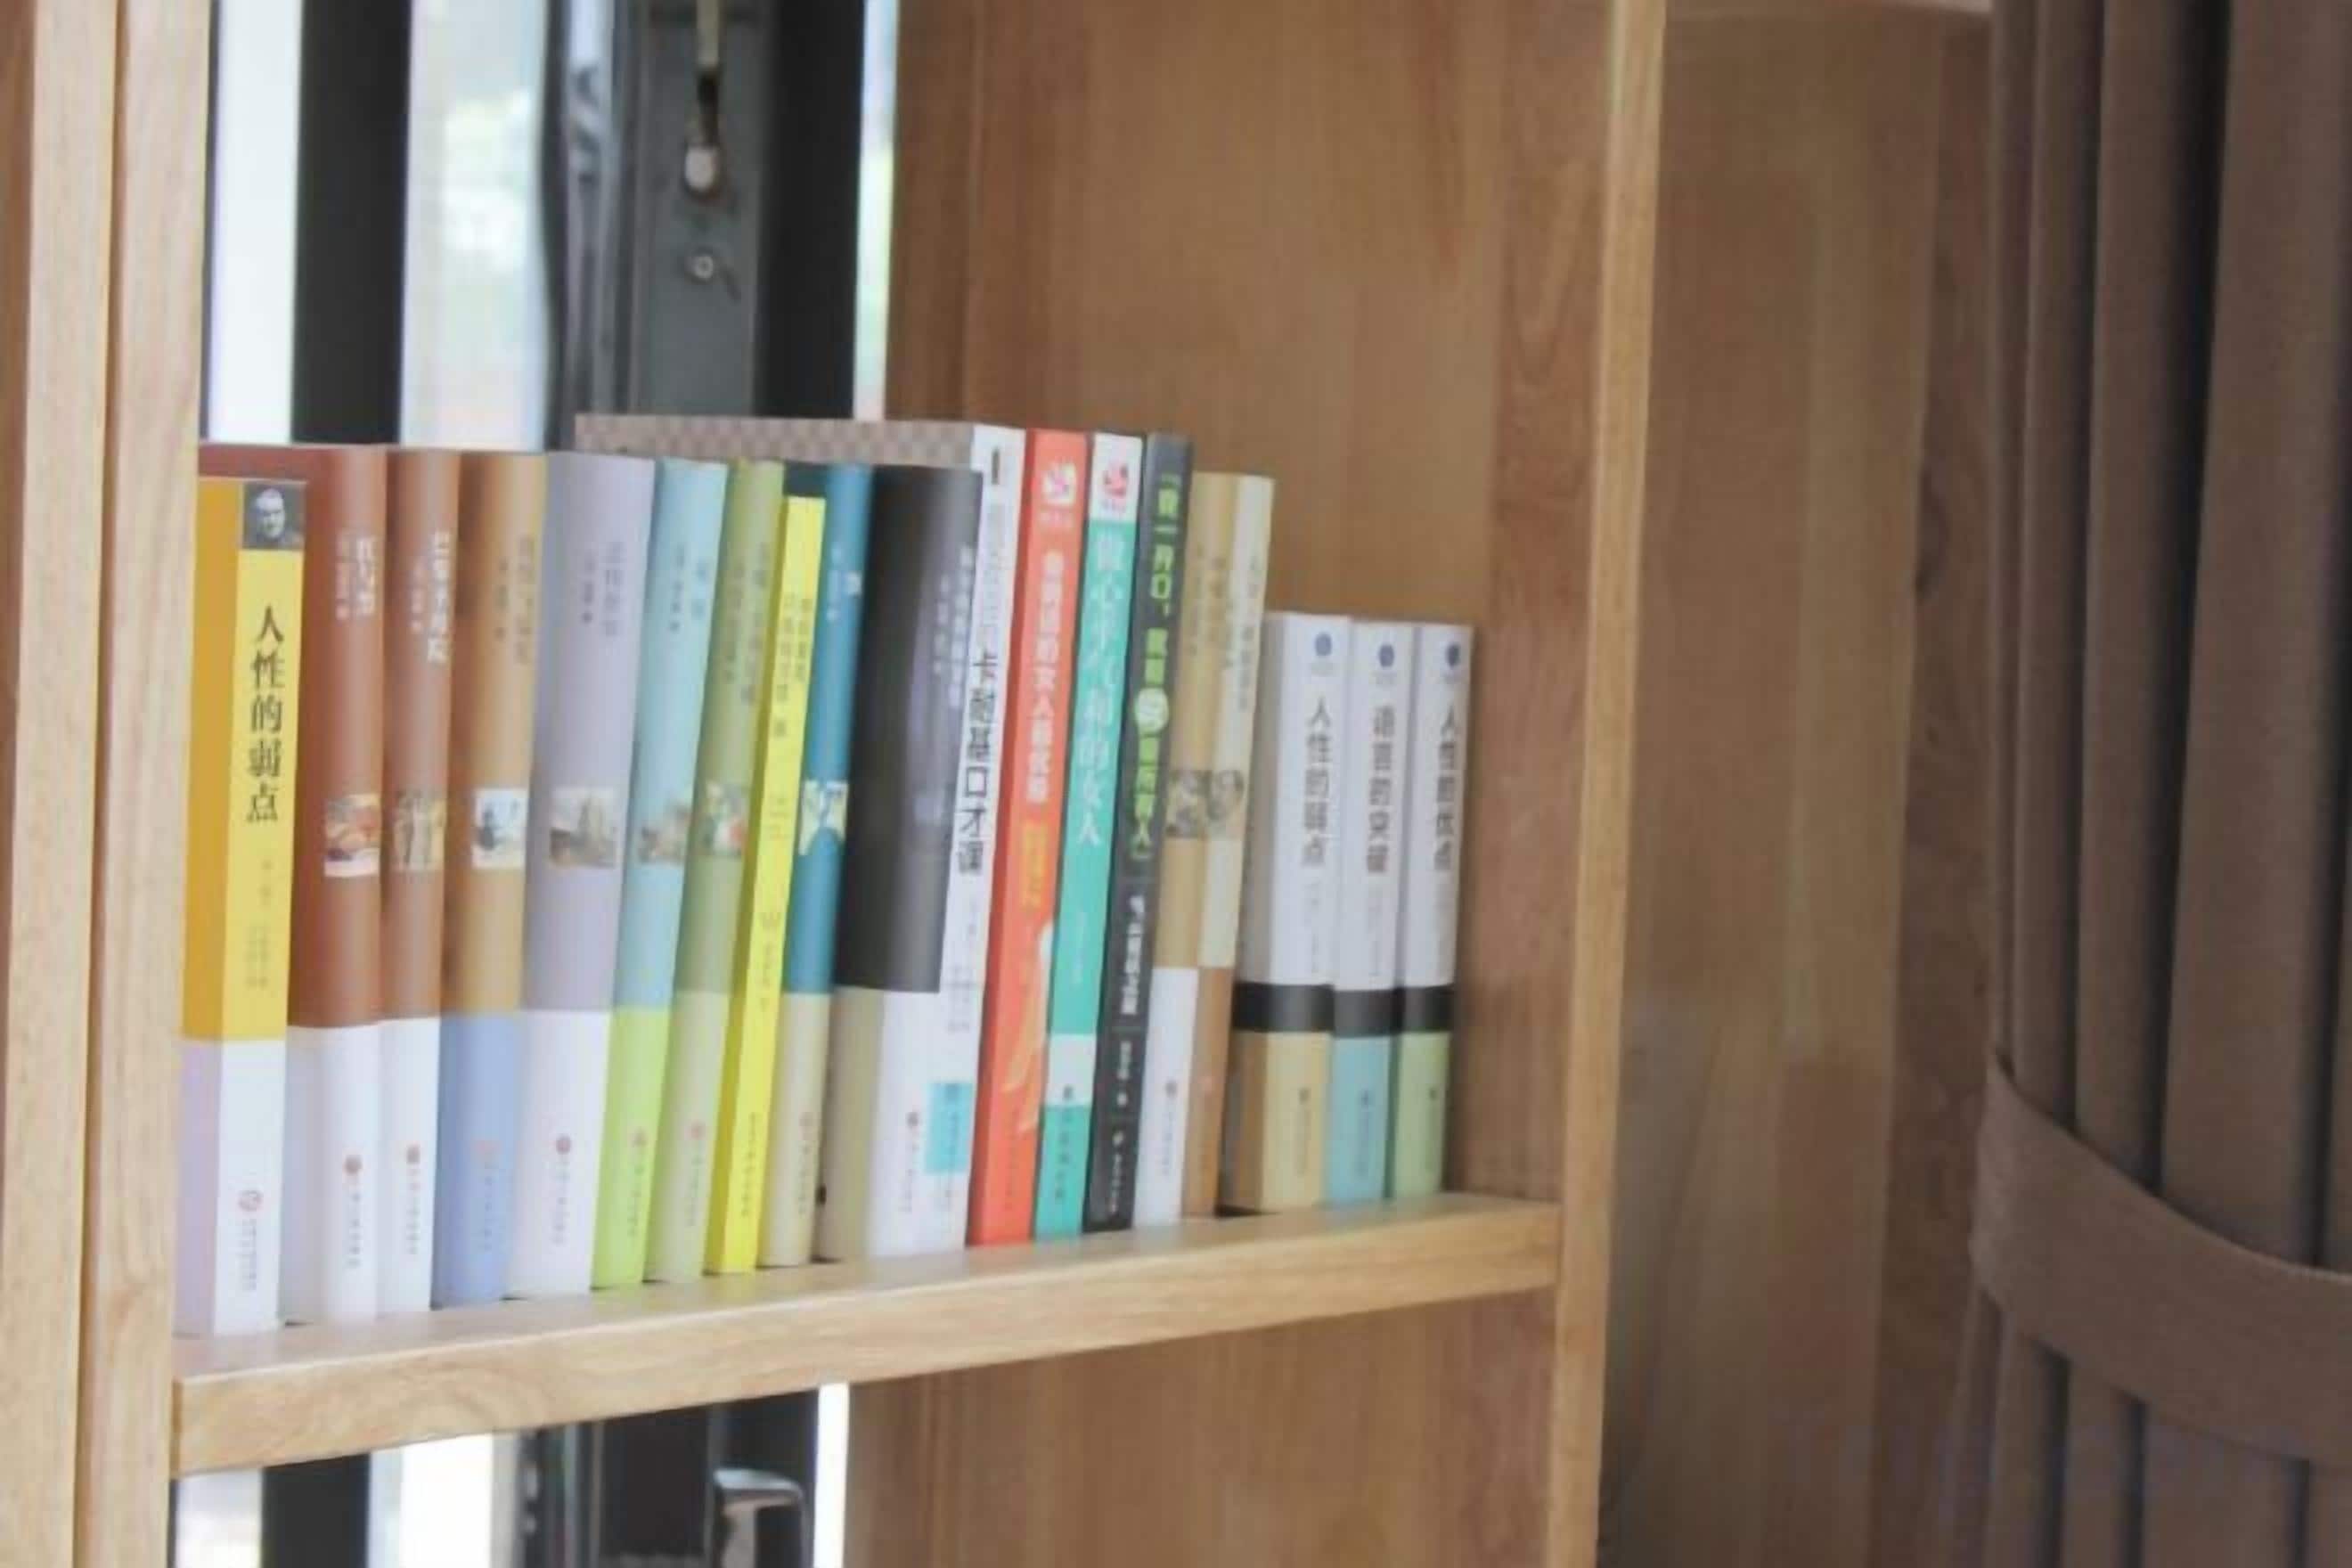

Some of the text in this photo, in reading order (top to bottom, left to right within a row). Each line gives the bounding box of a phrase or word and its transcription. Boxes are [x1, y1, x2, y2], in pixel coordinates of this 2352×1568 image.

[246, 605, 284, 822] 人性的弱点
[1302, 695, 1333, 868] 人性的弱点
